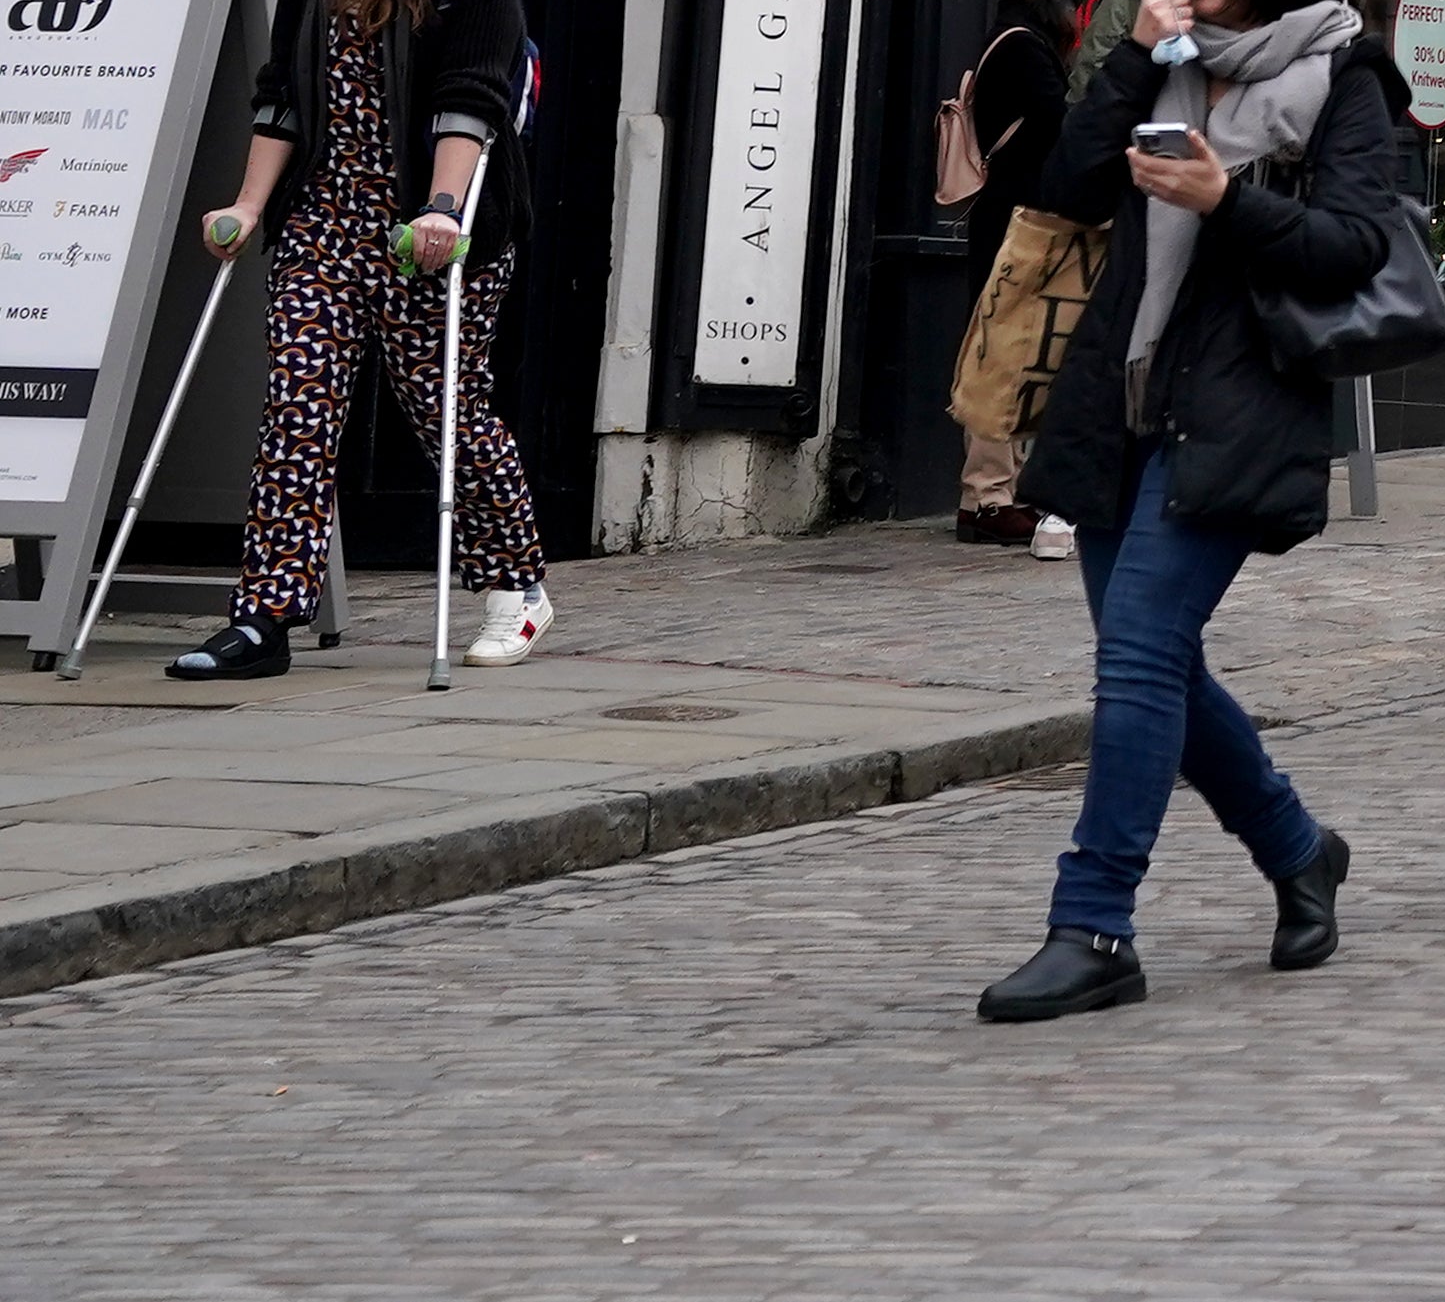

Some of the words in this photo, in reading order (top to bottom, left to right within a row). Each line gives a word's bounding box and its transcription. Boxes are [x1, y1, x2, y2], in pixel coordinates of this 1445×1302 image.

[1402, 4, 1443, 23] PERFECT
[1414, 46, 1435, 64] 30%
[12, 64, 93, 78] FAVOURITE
[97, 65, 157, 78] BRANDS
[0, 110, 31, 125] NTONY
[32, 111, 72, 125] MORATO
[81, 108, 129, 130] MAC
[60, 158, 128, 174] Matinique
[740, 71, 783, 253] ANGEL
[0, 200, 34, 214] RKER
[69, 204, 120, 218] FARAH
[38, 252, 63, 261] GYM
[84, 253, 112, 262] KING
[6, 307, 49, 320] MORE
[705, 319, 787, 343] SHOPS
[23, 382, 67, 401] WAY!
